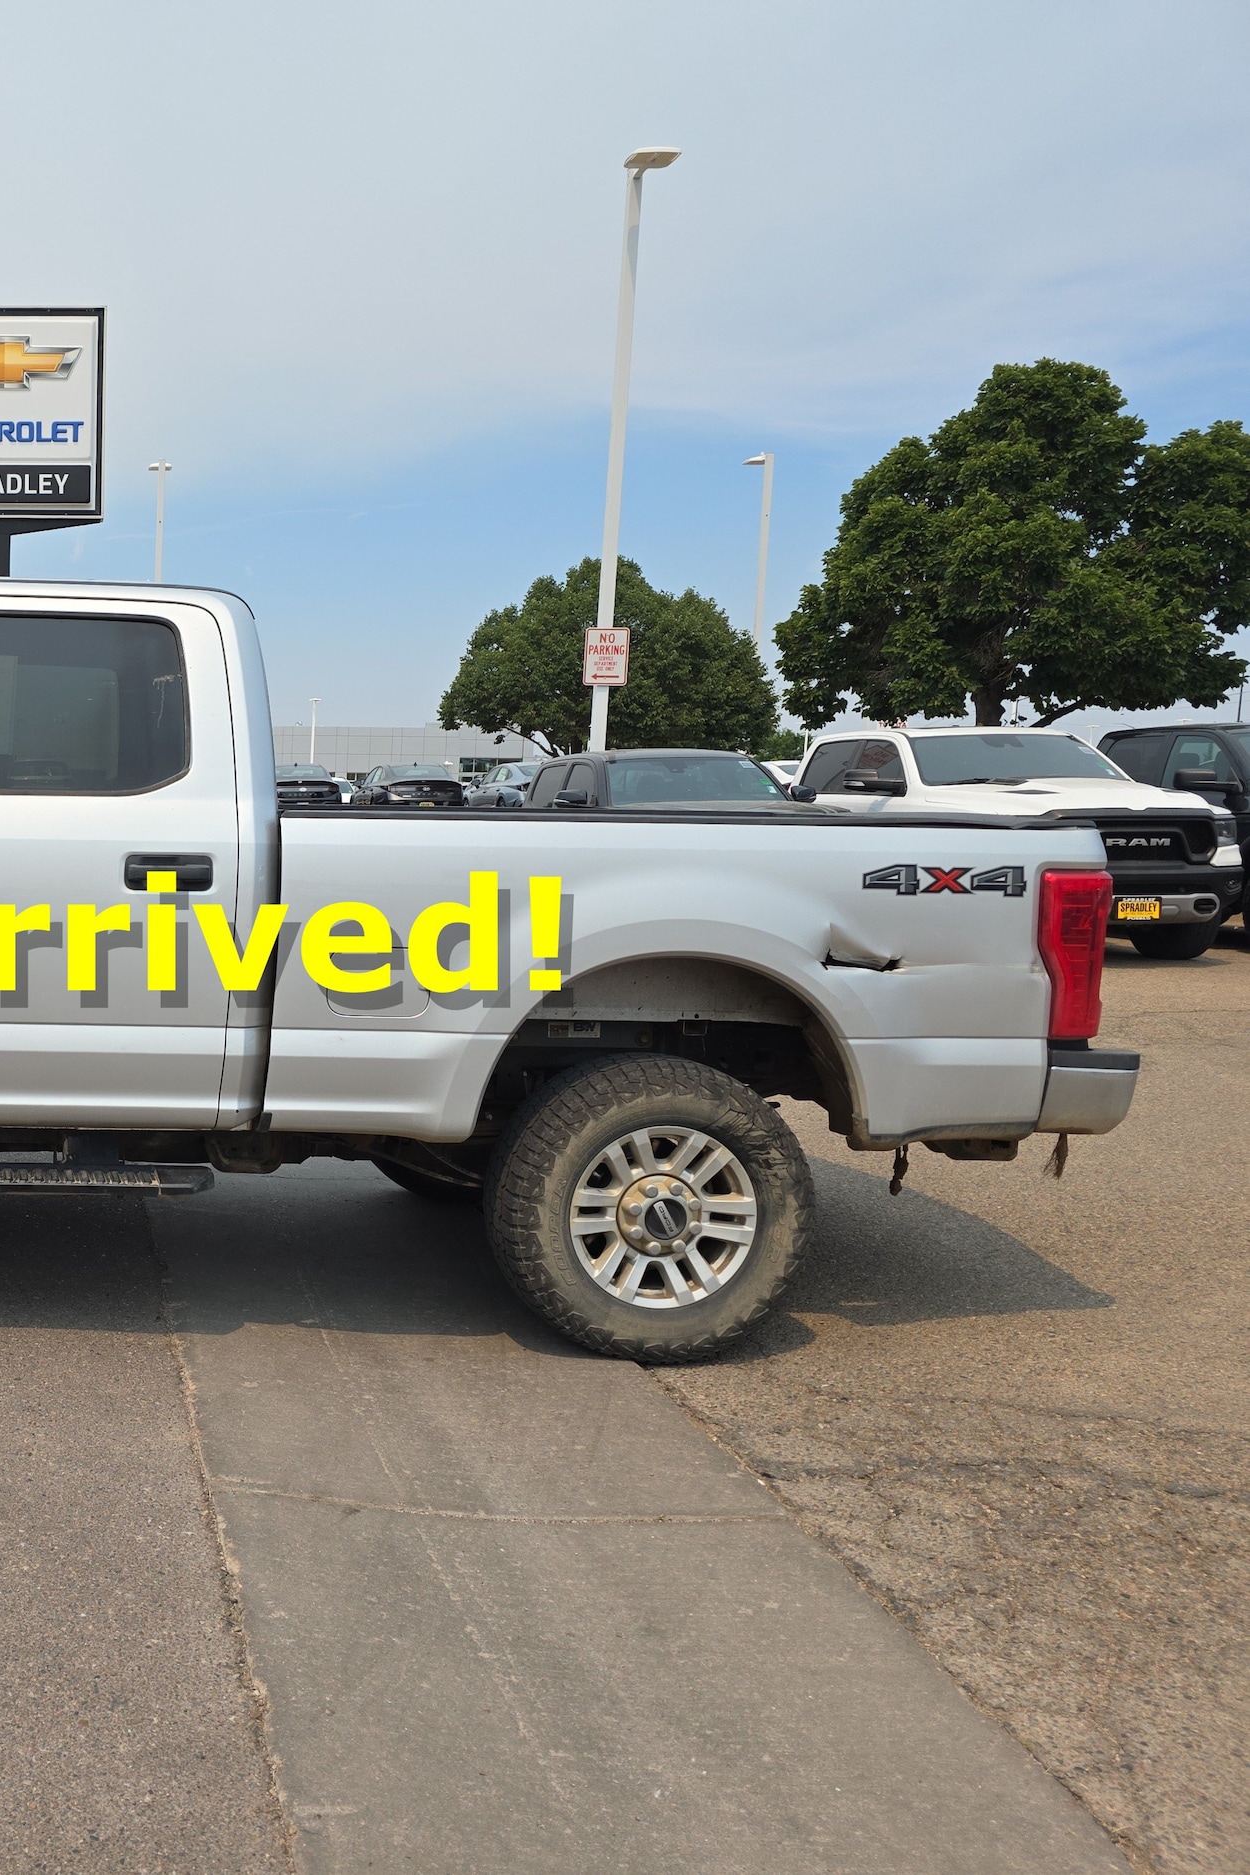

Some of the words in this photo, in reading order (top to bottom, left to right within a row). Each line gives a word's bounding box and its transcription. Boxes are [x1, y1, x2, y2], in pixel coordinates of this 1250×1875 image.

[599, 633, 615, 643] NO
[588, 645, 625, 655] PARKING
[1105, 837, 1171, 847] RAM
[1120, 902, 1158, 913] SPRADLEY
[658, 1205, 675, 1233] FORD
[550, 1177, 577, 1286] COOPER
